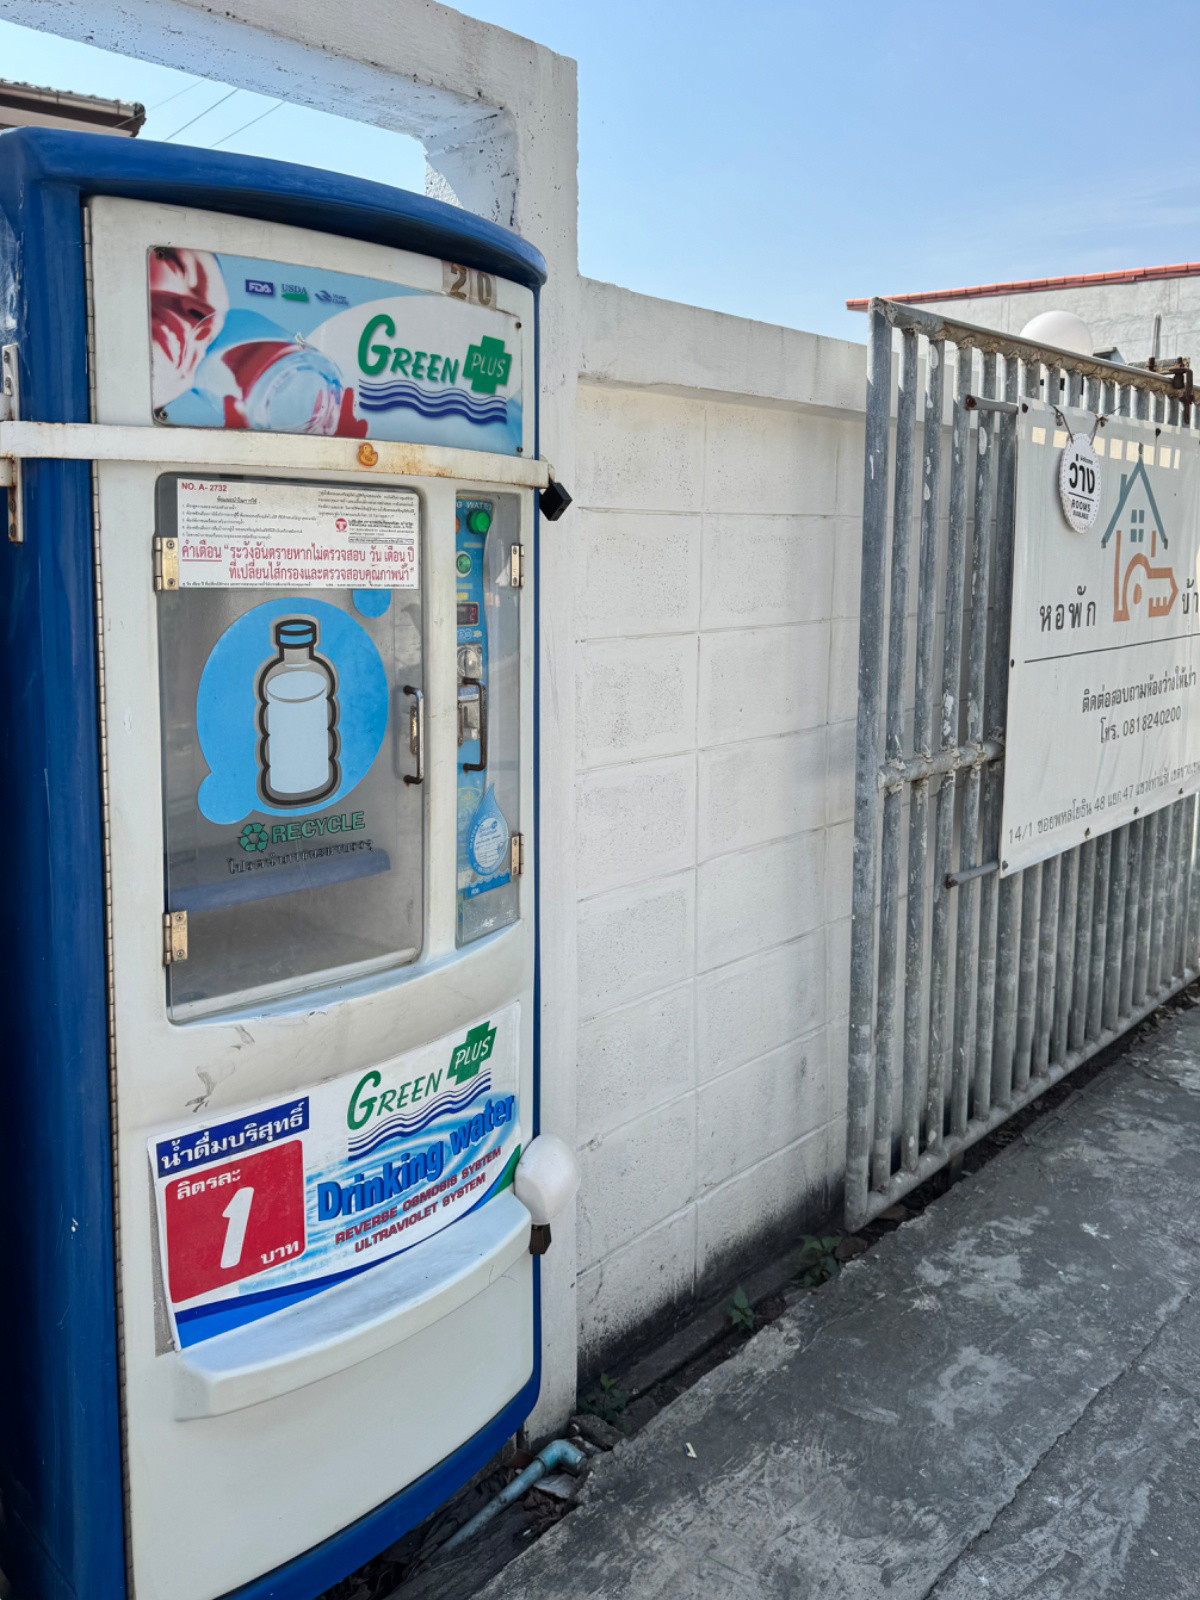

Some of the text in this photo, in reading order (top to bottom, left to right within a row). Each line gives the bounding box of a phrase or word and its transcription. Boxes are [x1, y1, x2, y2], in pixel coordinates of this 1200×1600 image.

[249, 282, 272, 293] FDA
[281, 284, 307, 294] USDA
[450, 263, 492, 306] 20
[470, 352, 508, 378] PLUS
[181, 482, 197, 491] NO.
[182, 540, 222, 559] คำเตือน
[369, 545, 383, 563] วัน
[384, 545, 406, 563] เดือน
[407, 545, 415, 563] ปี
[1040, 585, 1097, 632] หอพัก
[271, 811, 366, 844] RECYCLE
[1009, 822, 1033, 844] 14/1
[1094, 796, 1105, 812] 48
[455, 1035, 490, 1070] PLUS
[162, 1103, 305, 1170] น้ำดื่มบริสุทธิ์
[317, 1095, 515, 1222] Drinking water
[177, 1169, 241, 1200] ลิตรละ
[335, 1146, 502, 1246] REVERSE OSMOSIS SYSTEM
[220, 1186, 255, 1270] 1
[355, 1172, 487, 1254] ULTRAVIOLET SYSTEM
[261, 1240, 300, 1266] บาท
